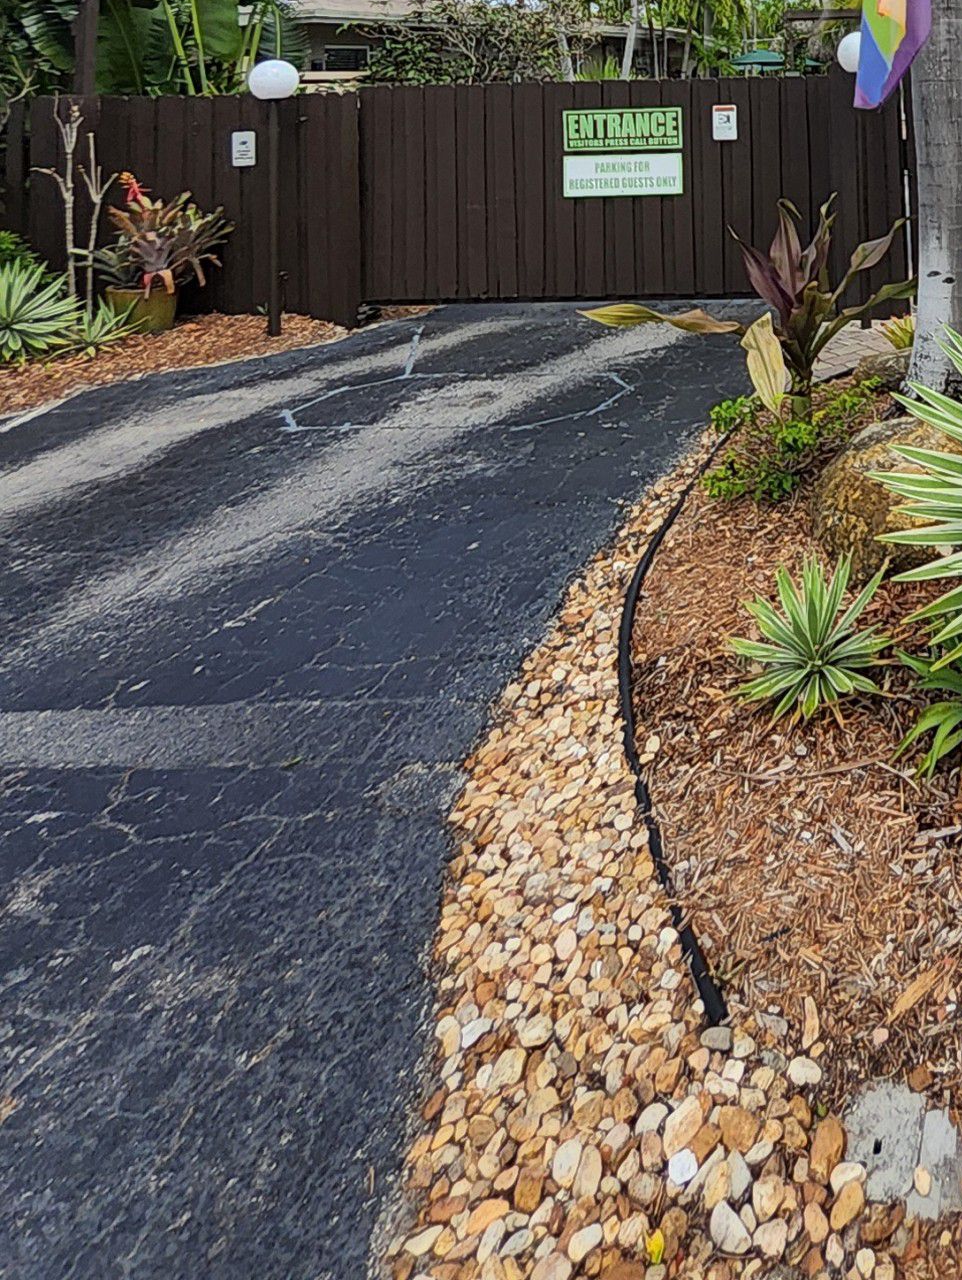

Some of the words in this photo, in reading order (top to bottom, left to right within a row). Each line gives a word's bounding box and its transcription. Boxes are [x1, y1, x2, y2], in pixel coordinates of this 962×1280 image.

[568, 112, 678, 139] ENTRANCE
[569, 139, 604, 148] VISITORS
[605, 138, 629, 147] PRESS
[630, 138, 648, 146] CALL
[649, 137, 678, 145] BUTTON
[595, 161, 632, 174] PARKING
[634, 160, 650, 172] FOR
[569, 177, 620, 190] REGISTERED
[621, 177, 655, 189] GUESTS
[657, 176, 677, 187] ONLY
